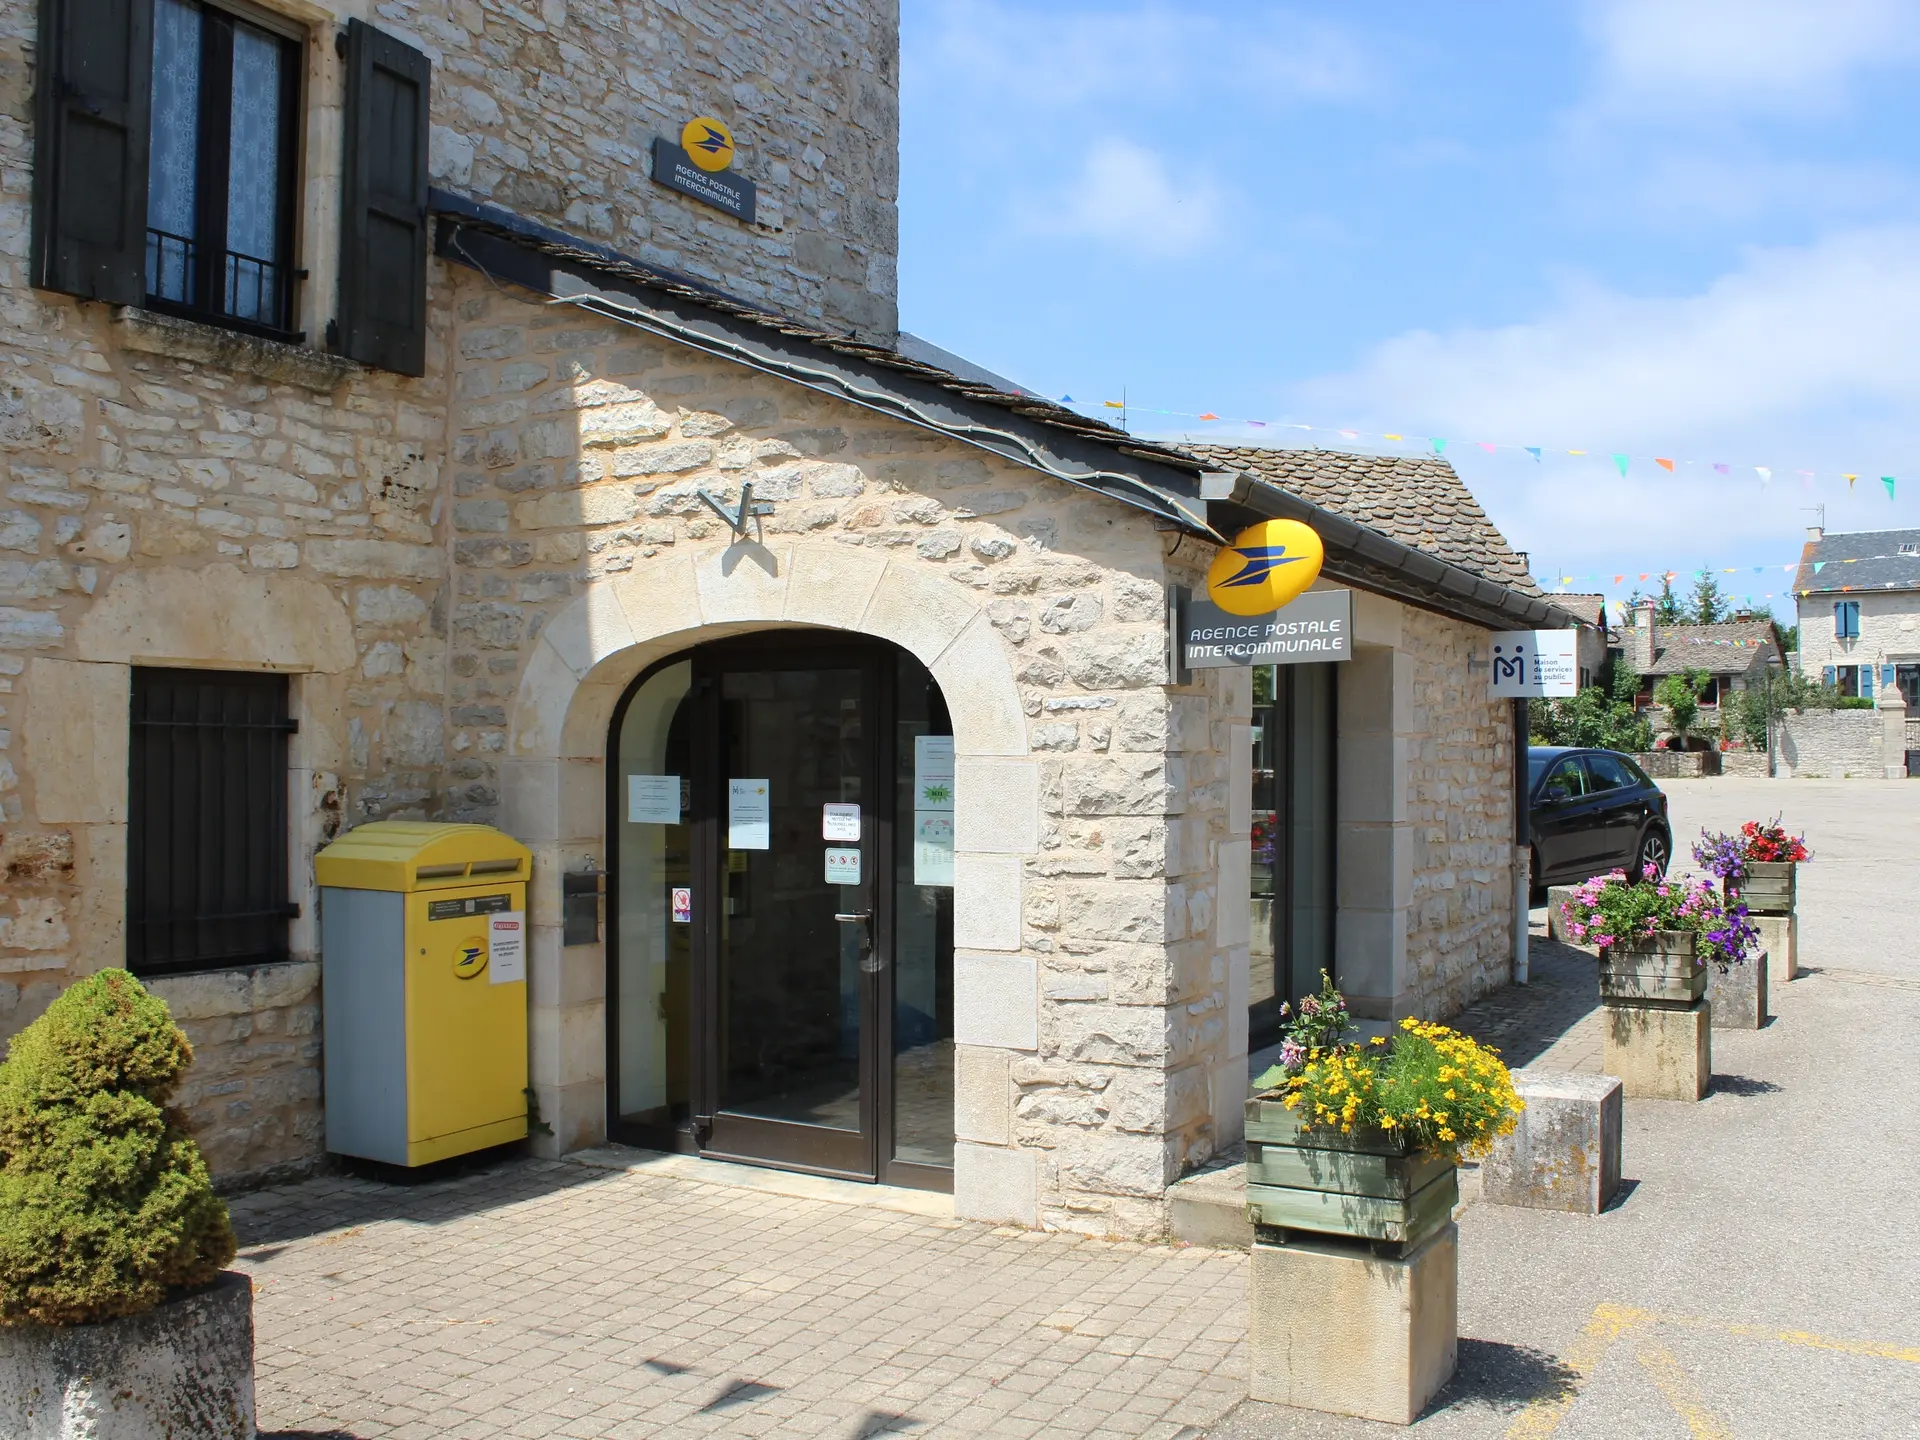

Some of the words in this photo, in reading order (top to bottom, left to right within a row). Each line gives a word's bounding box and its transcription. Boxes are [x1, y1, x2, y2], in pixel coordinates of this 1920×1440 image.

[674, 174, 741, 211] INTERCOMMUNALE
[675, 164, 708, 185] AGENCE
[709, 179, 741, 200] POSTALE
[1190, 625, 1259, 641] AGENCE
[1265, 619, 1342, 636] POSTALE
[1189, 637, 1344, 659] INTERCOMMUNALE
[1543, 673, 1566, 681] public
